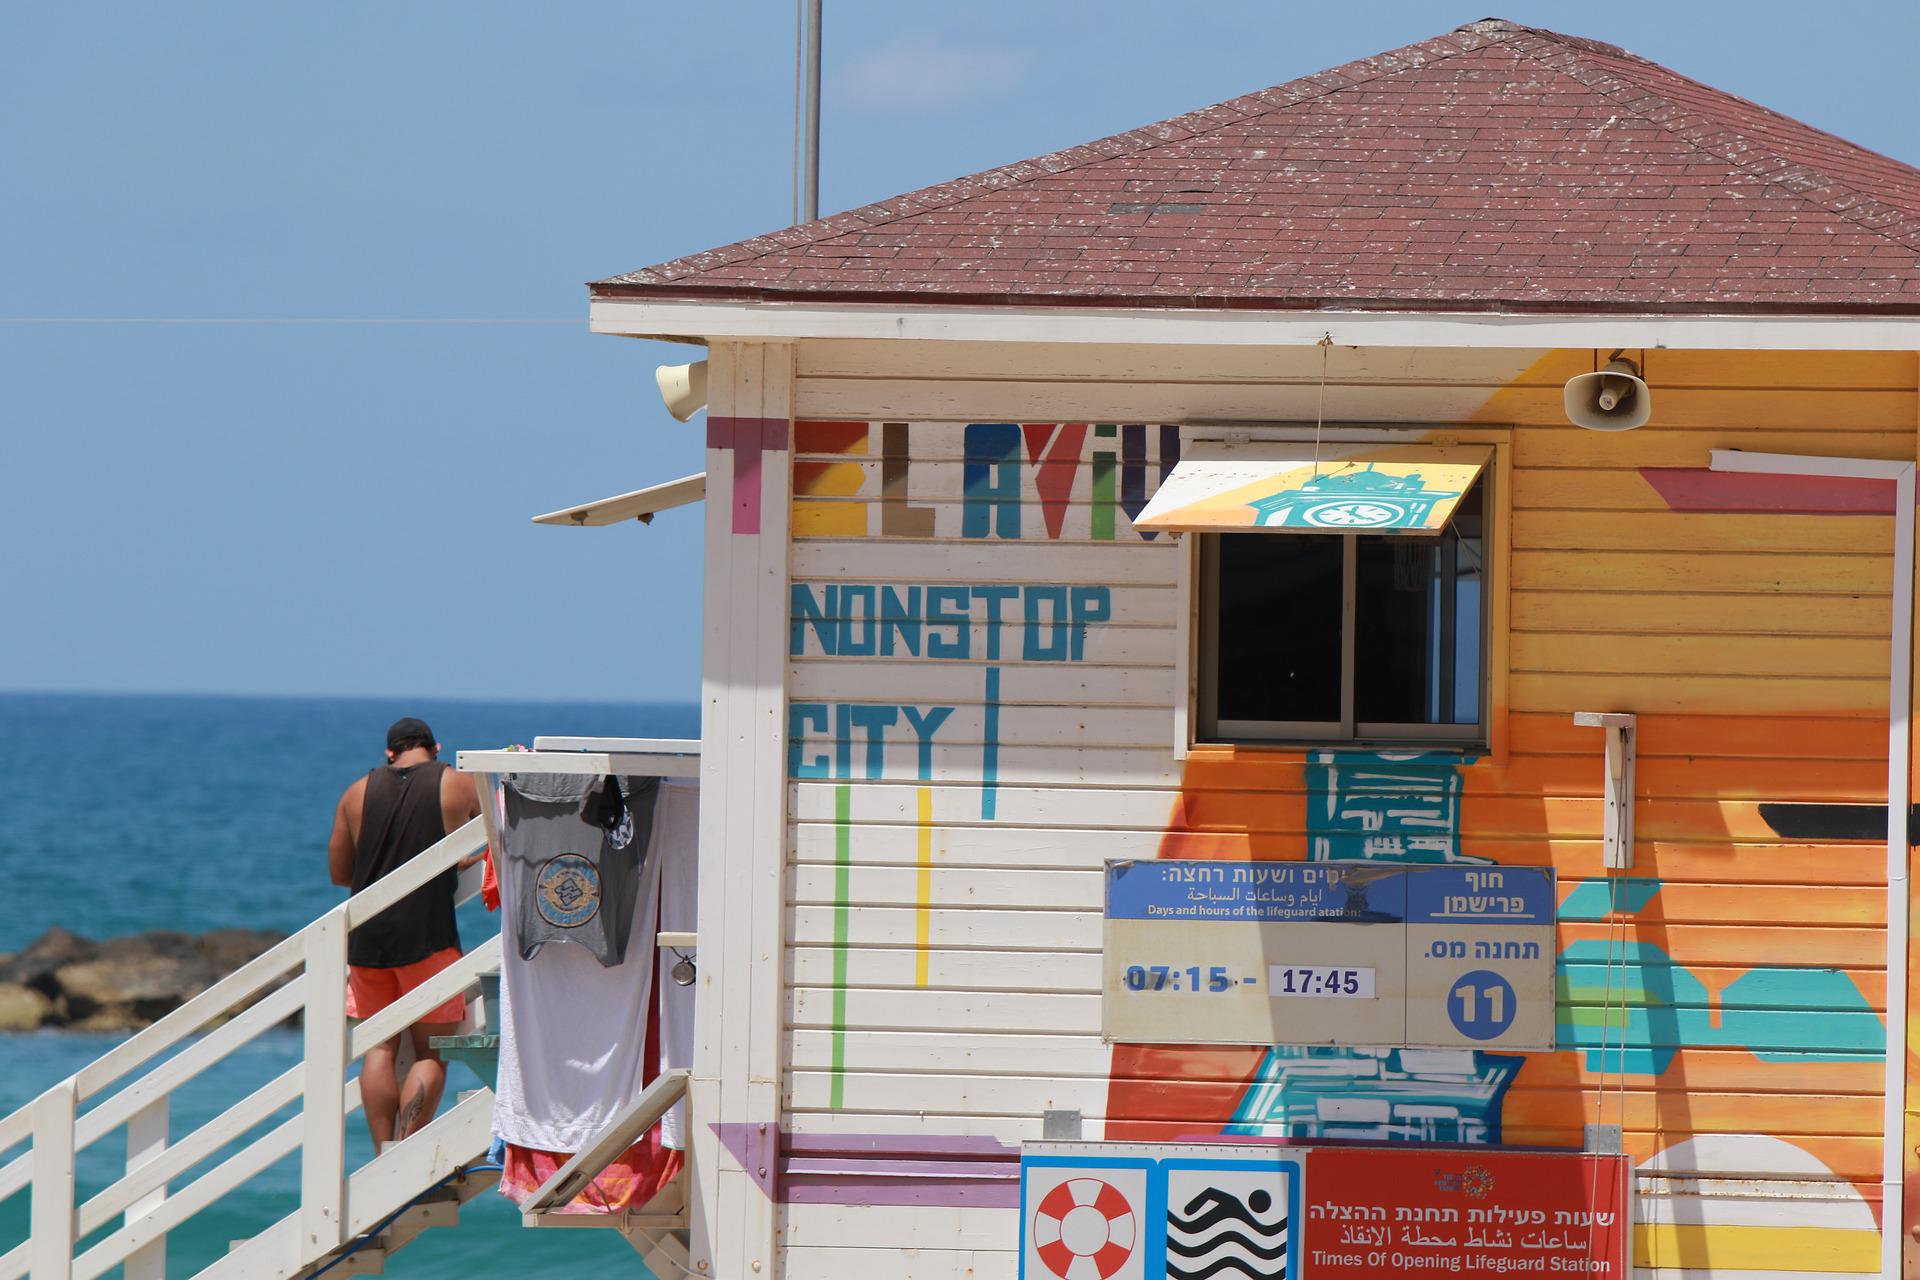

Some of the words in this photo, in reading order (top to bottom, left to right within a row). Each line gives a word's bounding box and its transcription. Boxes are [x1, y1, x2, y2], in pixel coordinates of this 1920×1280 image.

[790, 583, 1111, 662] NONSTOP
[788, 703, 956, 781] CITY
[1161, 866, 1224, 884] רחצה:
[1232, 867, 1294, 885] ושעות
[1465, 872, 1504, 893] חוף
[1187, 886, 1240, 905] السباحة
[1444, 895, 1525, 915] פרישמן
[1148, 904, 1174, 917] Days
[1176, 905, 1197, 916] and
[1199, 905, 1231, 917] hours
[1233, 906, 1245, 917] of
[1246, 906, 1265, 917] the
[1266, 906, 1316, 919] lifeguard
[1424, 940, 1466, 959] מס.
[1475, 941, 1540, 960] תחנה
[1126, 965, 1229, 992] 07:15
[1283, 969, 1359, 994] 17:45
[1455, 984, 1504, 1023] 11
[1310, 1201, 1387, 1221] ההצלה
[1395, 1206, 1459, 1223] תחנת
[1467, 1204, 1546, 1226] פעילות
[1554, 1210, 1616, 1228] שעות
[1340, 1224, 1392, 1247] الانقاذ
[1401, 1225, 1457, 1247] محطة
[1463, 1225, 1513, 1248] نشاط
[1520, 1228, 1587, 1250] ساعات
[1312, 1250, 1363, 1266] Times
[1368, 1251, 1387, 1267] Of
[1391, 1252, 1462, 1272] Opening
[1466, 1254, 1545, 1273] Lifeguard
[1550, 1256, 1611, 1273] Station
